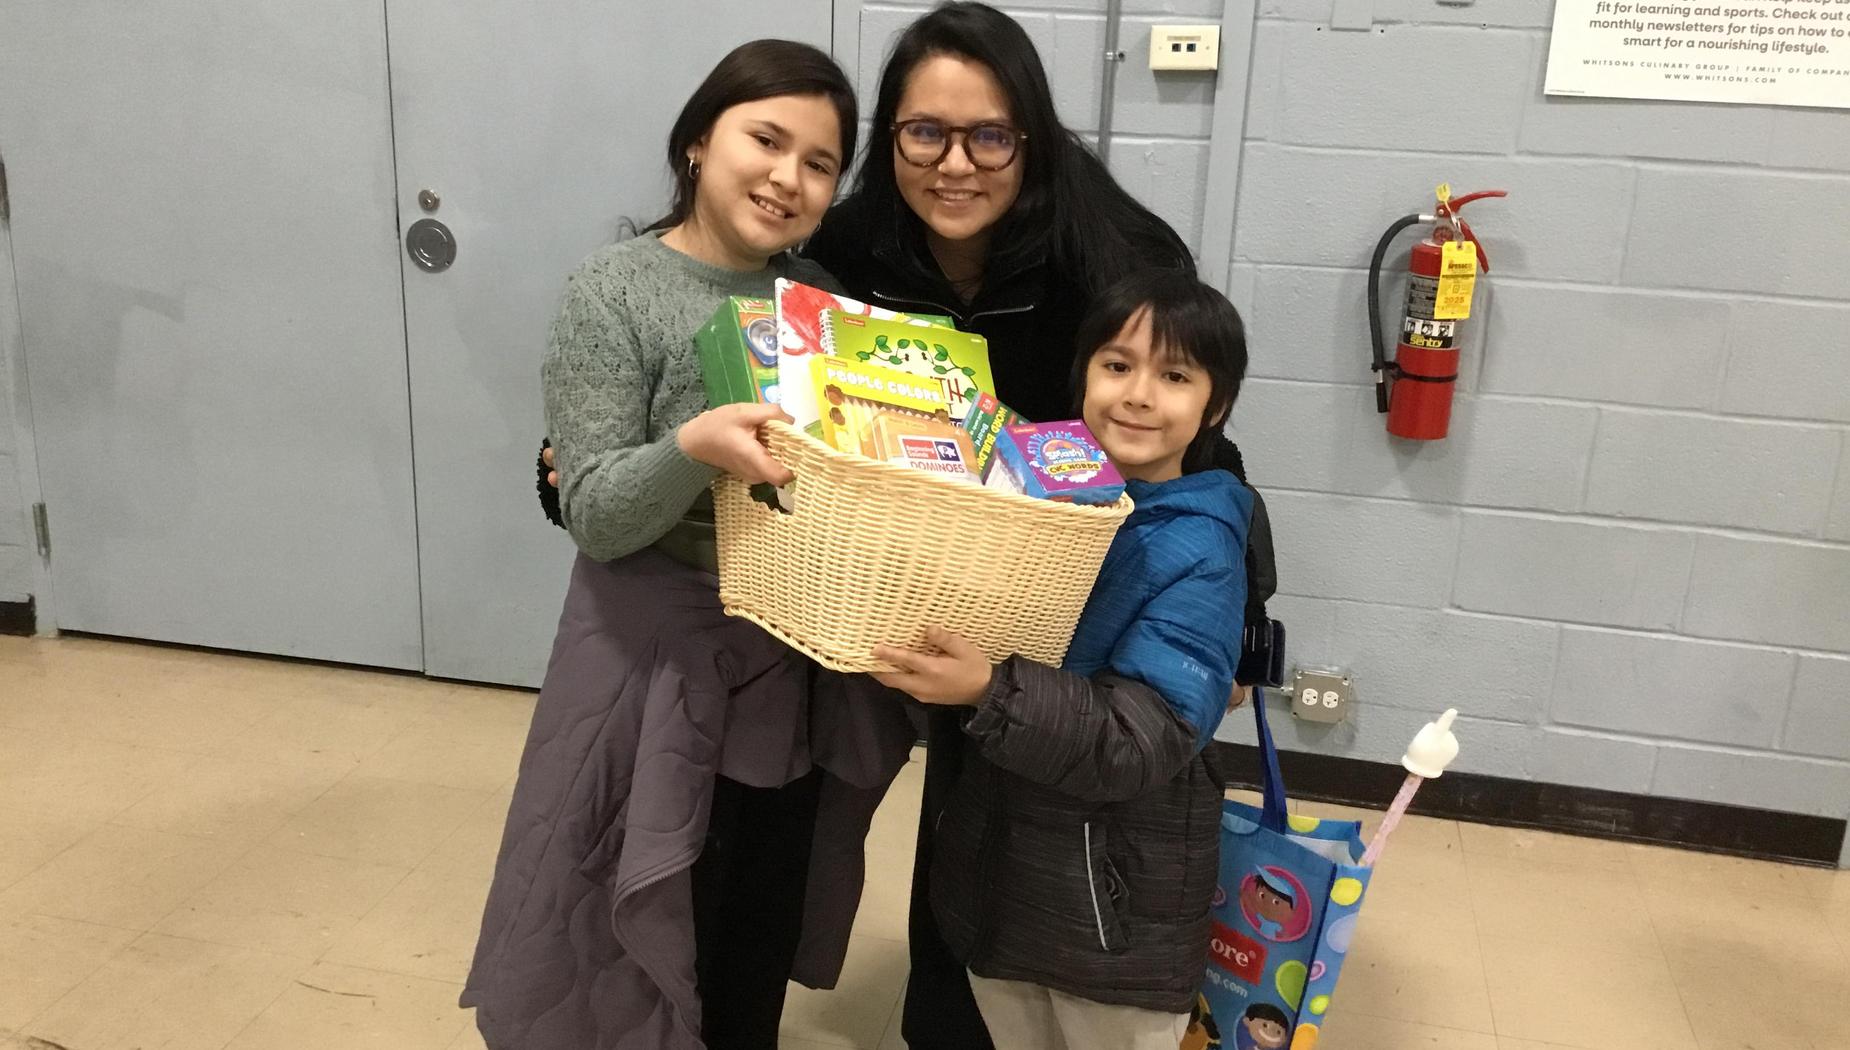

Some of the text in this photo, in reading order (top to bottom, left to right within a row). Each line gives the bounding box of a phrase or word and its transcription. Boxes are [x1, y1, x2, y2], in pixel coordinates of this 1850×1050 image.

[1596, 1, 1611, 15] fit
[1613, 2, 1633, 15] for
[1635, 3, 1691, 18] learning
[1694, 5, 1721, 16] and
[1724, 8, 1768, 19] sports.
[1772, 8, 1817, 20] Check
[1820, 11, 1843, 20] out
[1589, 18, 1644, 32] monthly
[1647, 21, 1724, 33] newsletters
[1726, 22, 1746, 36] for
[1750, 23, 1774, 36] tips
[1777, 26, 1794, 35] on
[1798, 25, 1827, 36] how
[1831, 27, 1844, 37] to
[1623, 36, 1829, 55] smart for a nourishing lifestyle.
[1583, 59, 1634, 67] WHITSONS
[1640, 61, 1690, 69] CULINARY
[1664, 73, 1776, 84] WWW.WHITSONS.COM
[1410, 335, 1443, 348] Sentry
[910, 461, 965, 473] DOMINOES
